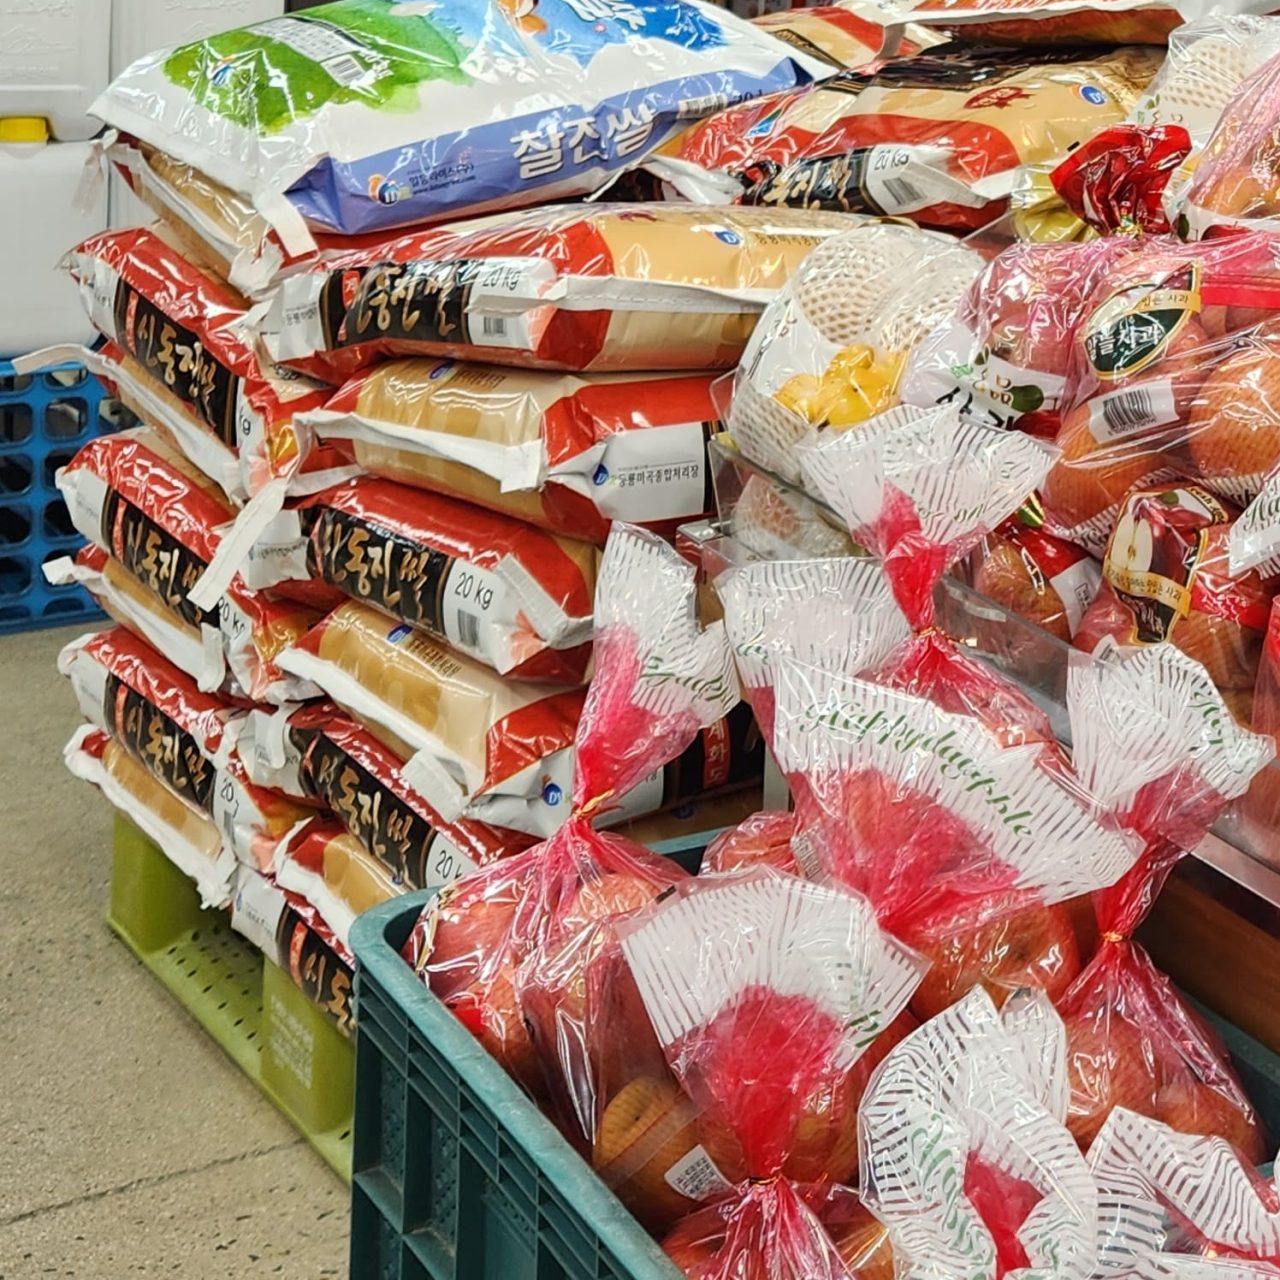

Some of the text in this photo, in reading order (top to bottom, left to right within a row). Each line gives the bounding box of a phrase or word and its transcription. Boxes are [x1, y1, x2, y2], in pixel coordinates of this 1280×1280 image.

[511, 105, 654, 179] 찰진쌀
[454, 571, 494, 611] 20 kg
[435, 850, 452, 879] 20
